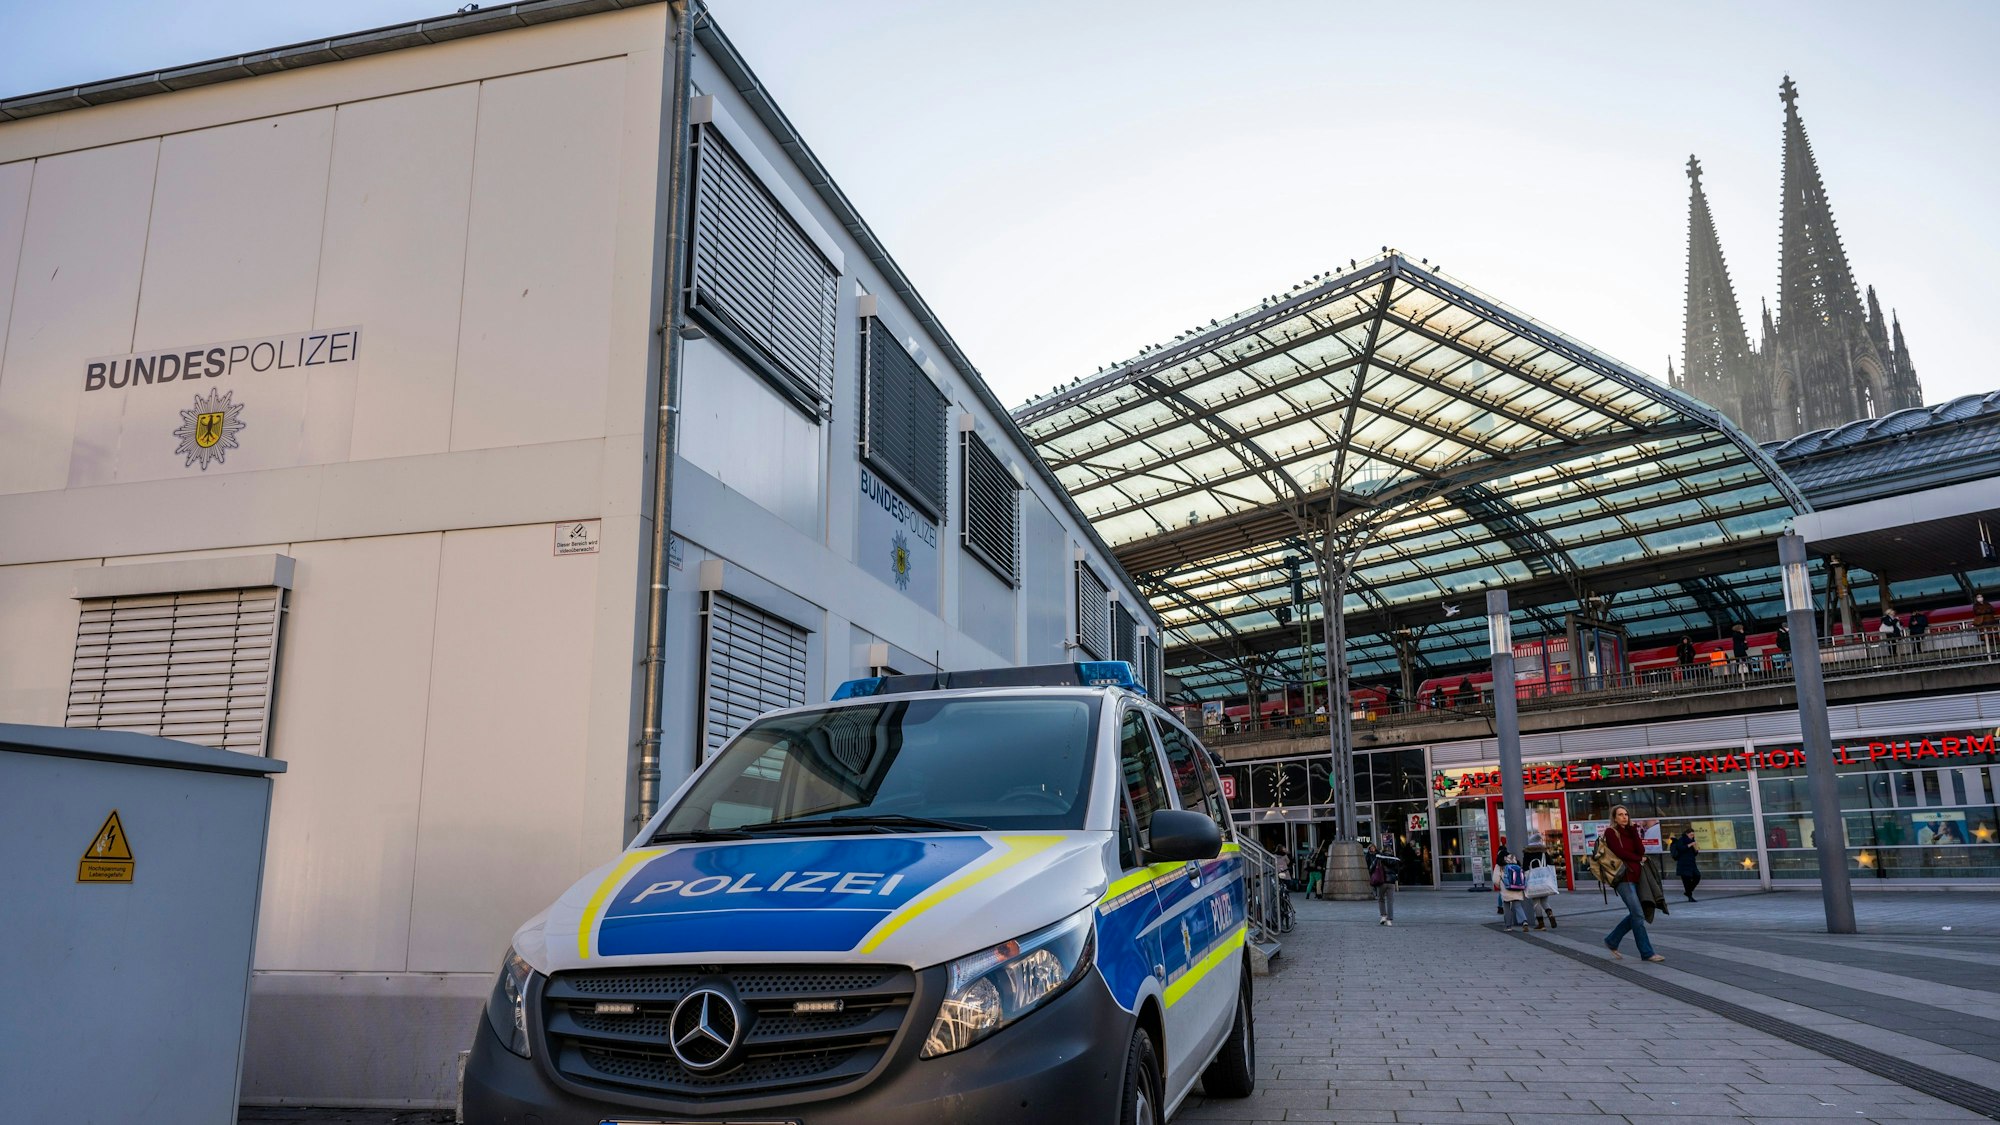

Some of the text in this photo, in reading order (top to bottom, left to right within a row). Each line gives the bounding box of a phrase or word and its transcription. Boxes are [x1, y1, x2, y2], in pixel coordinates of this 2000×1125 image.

[85, 331, 358, 391] BUNDESPOLIZEI
[861, 469, 937, 549] BUNDESPOLIZEI
[1459, 765, 1579, 788] APOHEKE
[1619, 745, 1856, 779] INTERNATIONL
[630, 871, 905, 904] POLIZEI
[1210, 892, 1232, 936] POLIZEI
